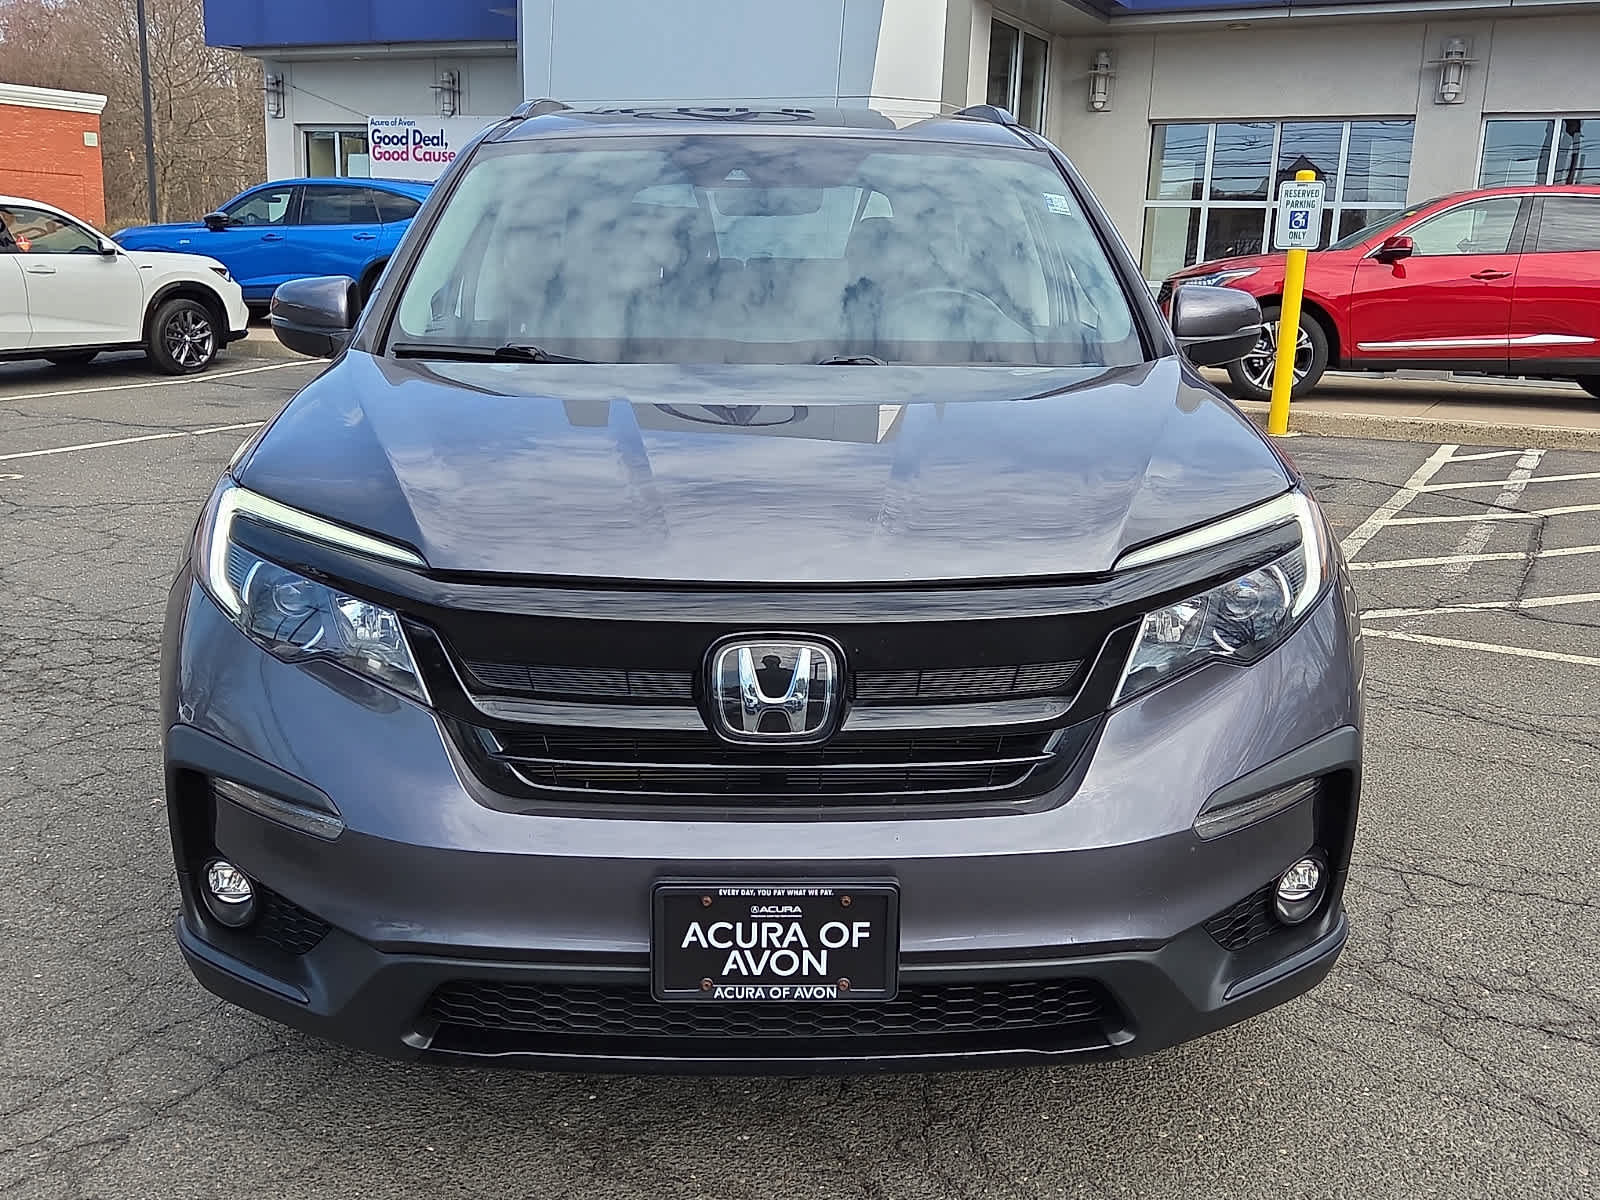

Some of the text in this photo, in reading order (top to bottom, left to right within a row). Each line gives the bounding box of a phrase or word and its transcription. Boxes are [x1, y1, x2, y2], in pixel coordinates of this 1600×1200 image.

[370, 118, 390, 127] Acura
[398, 118, 416, 127] Avon
[371, 128, 448, 149] Good Deal,
[372, 145, 456, 162] Good Cause
[1284, 189, 1320, 198] RESERVED
[1285, 200, 1316, 209] PARKING
[1288, 231, 1307, 240] ONLY
[740, 889, 756, 897] DAY,
[760, 905, 802, 913] ACURA
[681, 921, 871, 949] ACURA OF
[721, 949, 828, 976] AVON
[713, 986, 837, 999] ACURA OF AVON
